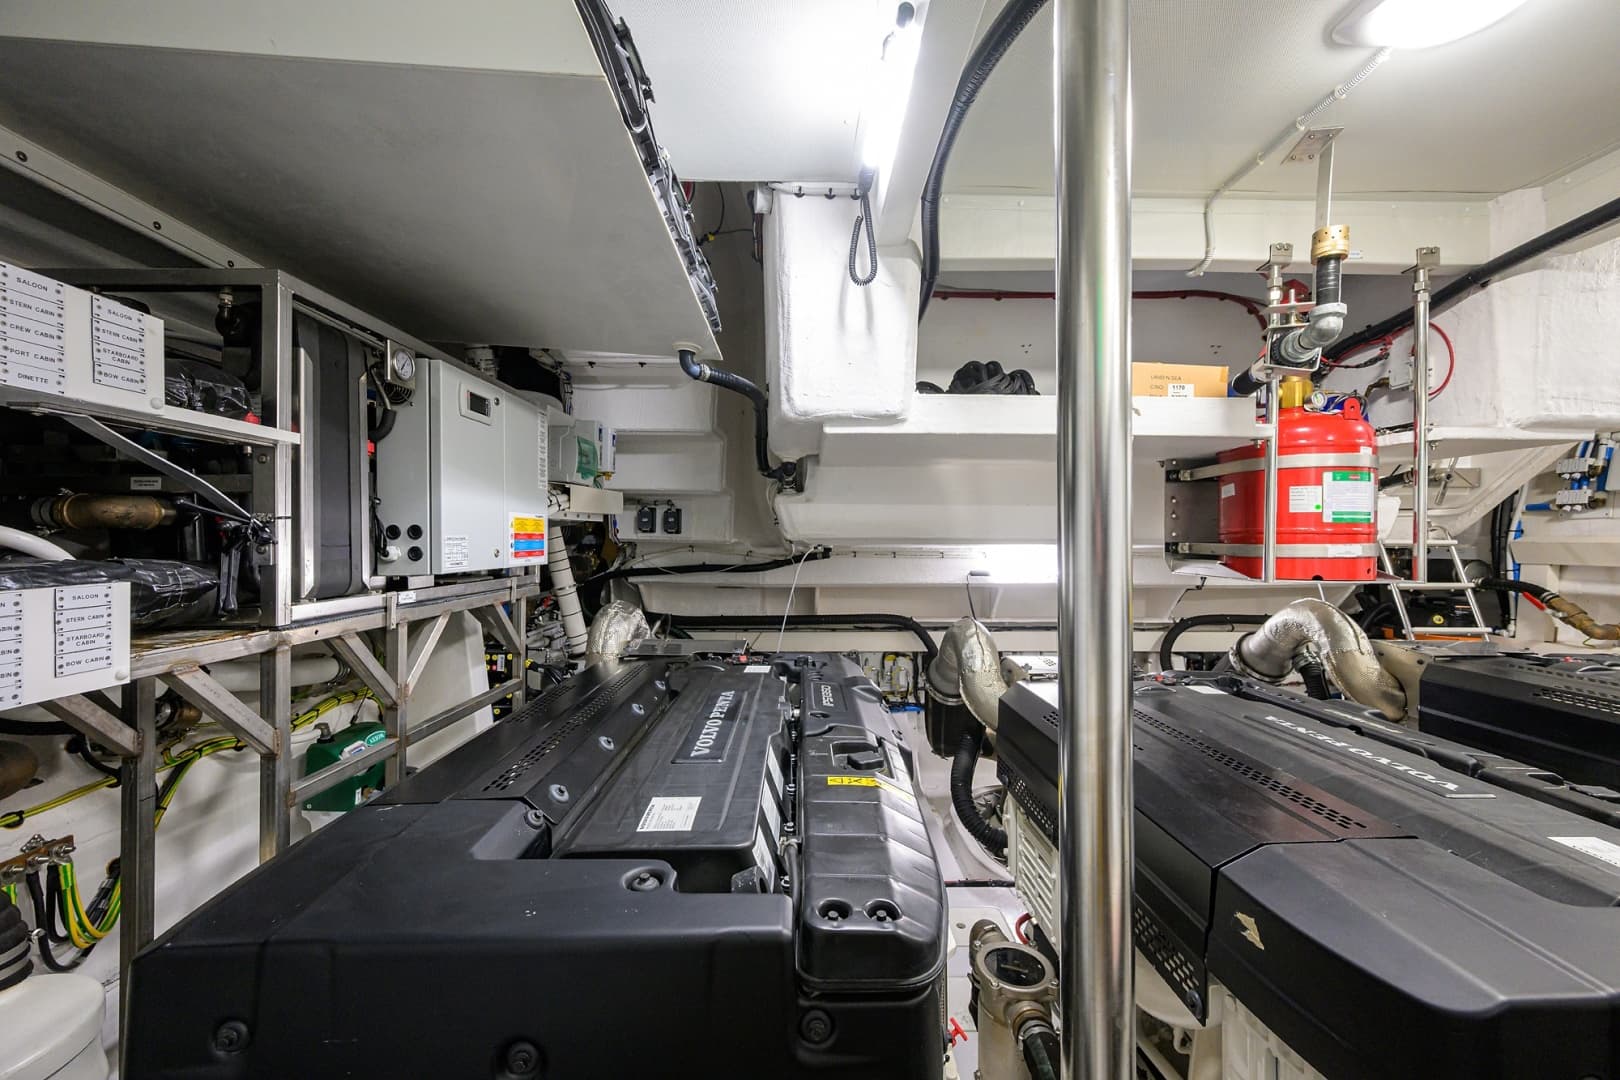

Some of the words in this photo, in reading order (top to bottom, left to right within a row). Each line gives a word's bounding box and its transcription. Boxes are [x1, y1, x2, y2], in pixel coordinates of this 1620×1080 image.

[16, 277, 49, 292] SALOON
[9, 299, 32, 311] STERN
[35, 306, 55, 317] CABIN
[107, 309, 133, 321] SALOON
[9, 323, 31, 334] CREW
[34, 330, 55, 340] CABIN
[101, 328, 121, 338] STERN
[121, 333, 138, 343] CABIN
[10, 348, 30, 358] PORT
[34, 353, 56, 363] CABIN
[103, 348, 139, 361] STARBOARD
[112, 356, 130, 365] CABIN
[17, 373, 49, 384] DINETTE
[103, 372, 119, 380] BOW
[121, 375, 139, 384] CABIN
[66, 633, 105, 642] STARBOARD
[85, 656, 105, 664] CABIN
[690, 719, 722, 757] VOLVO
[709, 690, 735, 719] PENTA
[1264, 715, 1349, 748] PENTA
[1348, 748, 1459, 791] VOLVO
